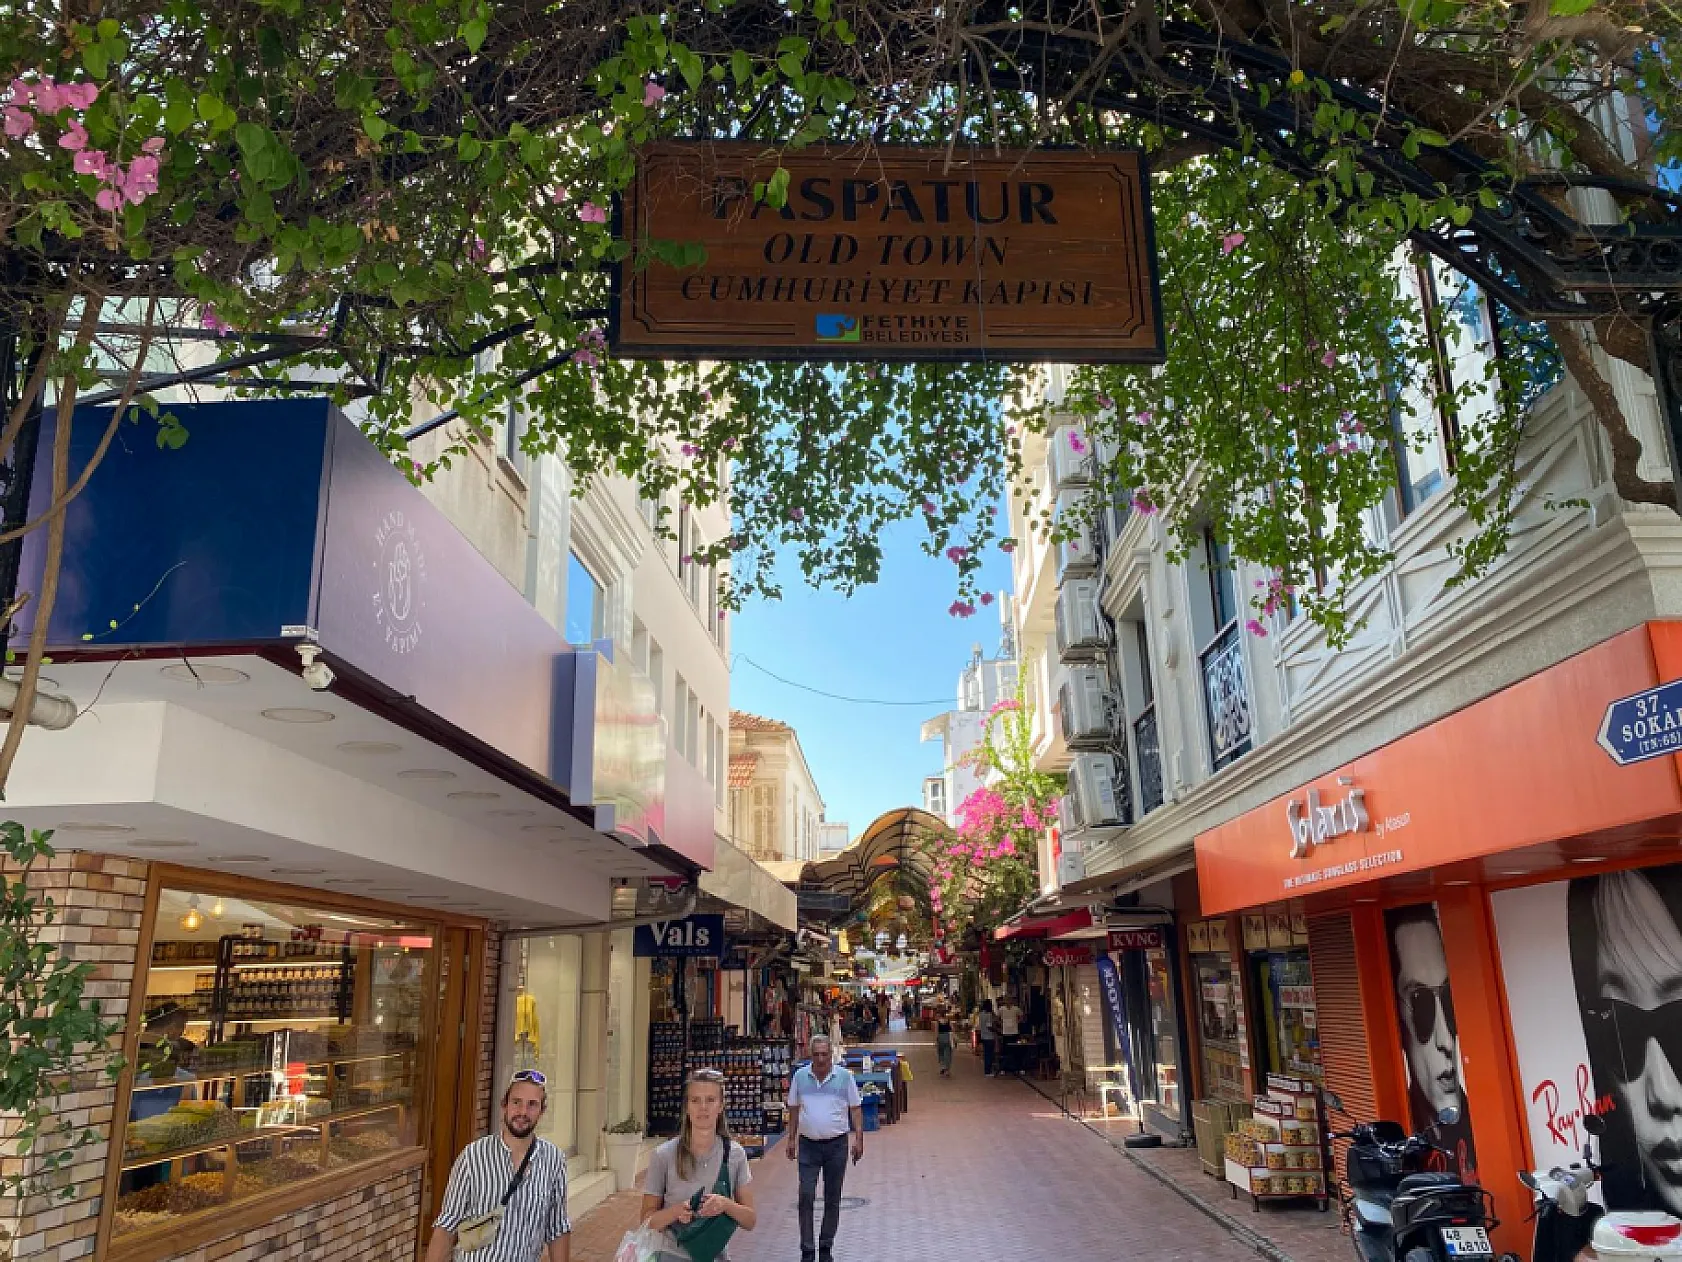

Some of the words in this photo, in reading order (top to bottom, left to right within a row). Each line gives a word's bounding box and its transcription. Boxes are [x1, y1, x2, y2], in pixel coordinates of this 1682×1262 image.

[711, 176, 1059, 226] PASPATUR
[763, 232, 859, 265] OLD
[876, 234, 1010, 267] TOWN
[680, 271, 951, 304] CUMHURİYET
[962, 279, 1095, 306] KAPISI
[1360, 849, 1403, 870] SELECTION
[650, 921, 710, 946] Vals
[1475, 1228, 1485, 1238] E
